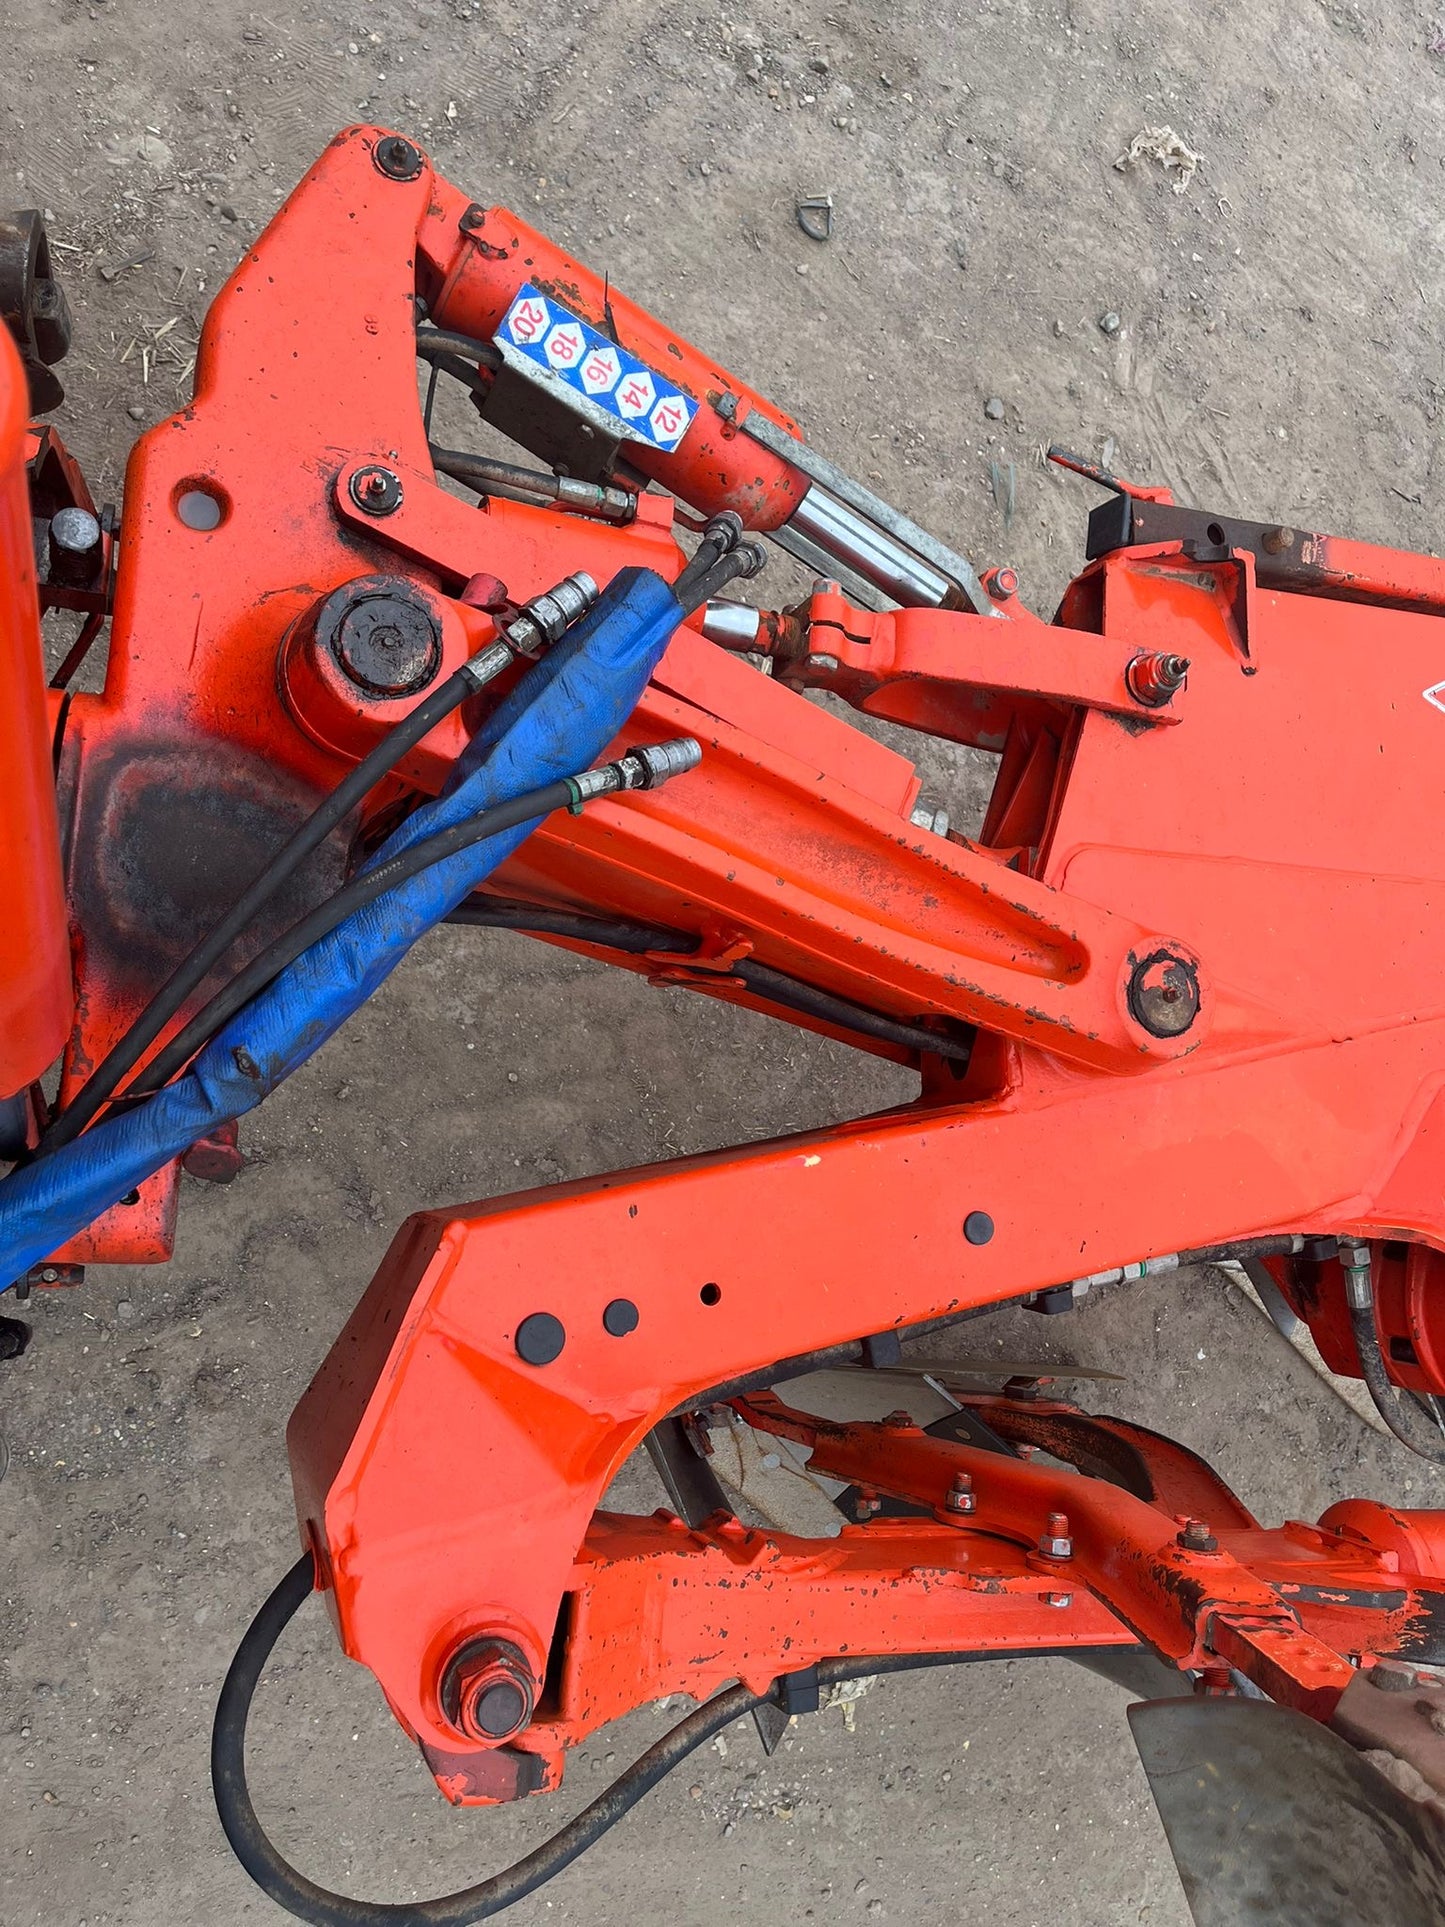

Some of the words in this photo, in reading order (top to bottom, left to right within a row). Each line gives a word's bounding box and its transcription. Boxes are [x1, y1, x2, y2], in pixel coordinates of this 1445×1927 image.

[513, 300, 544, 337] 20
[550, 332, 578, 360] 18
[585, 357, 613, 385] 16
[622, 381, 648, 409] 14
[654, 404, 682, 434] 12
